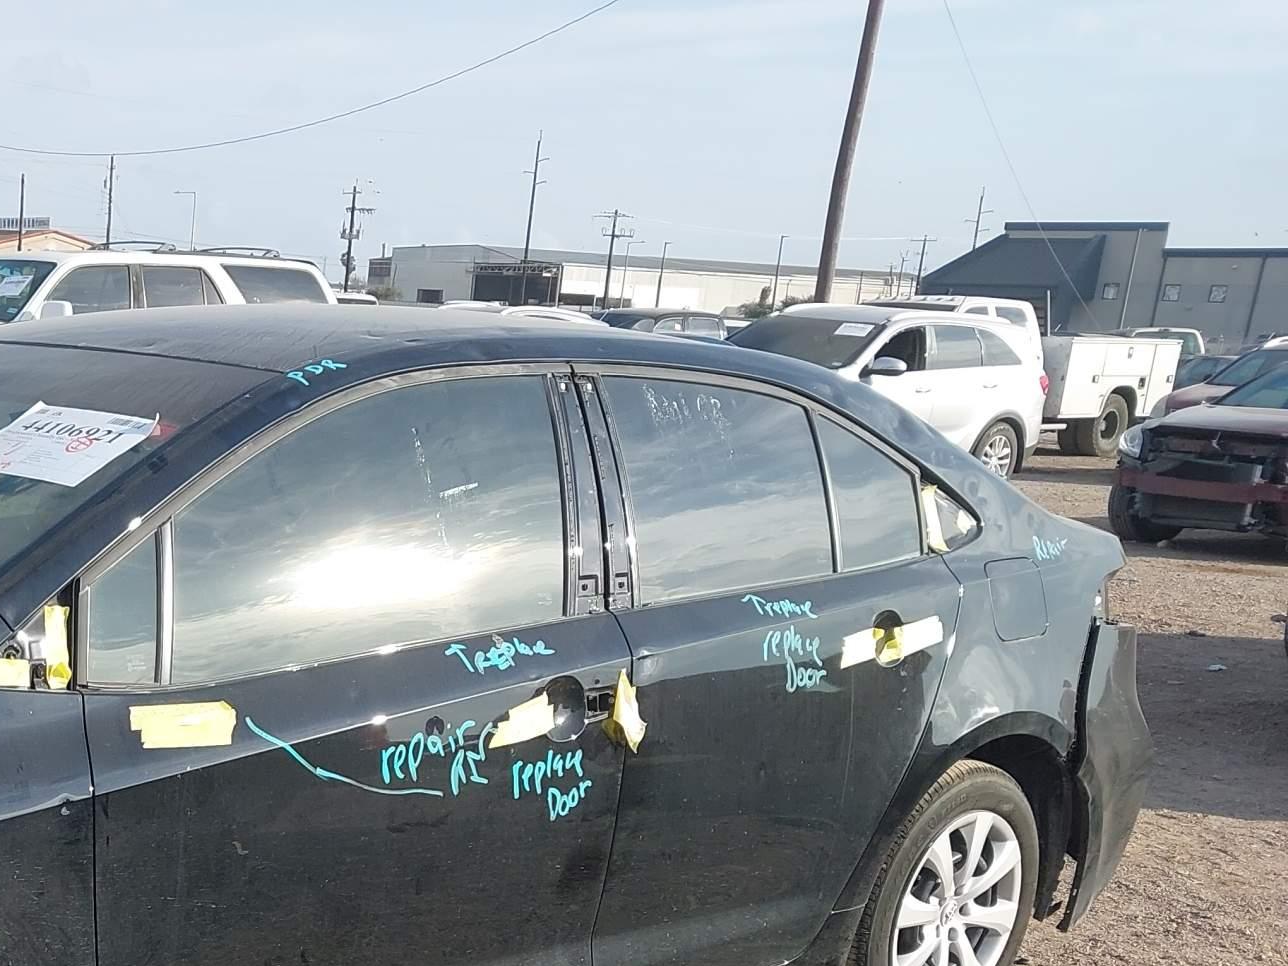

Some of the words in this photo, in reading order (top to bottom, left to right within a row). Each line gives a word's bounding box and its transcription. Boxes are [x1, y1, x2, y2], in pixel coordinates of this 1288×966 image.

[287, 359, 347, 386] PDR
[23, 419, 125, 444] 44106921
[785, 656, 827, 692] Door
[381, 719, 477, 785] repair
[547, 779, 592, 821] Door
